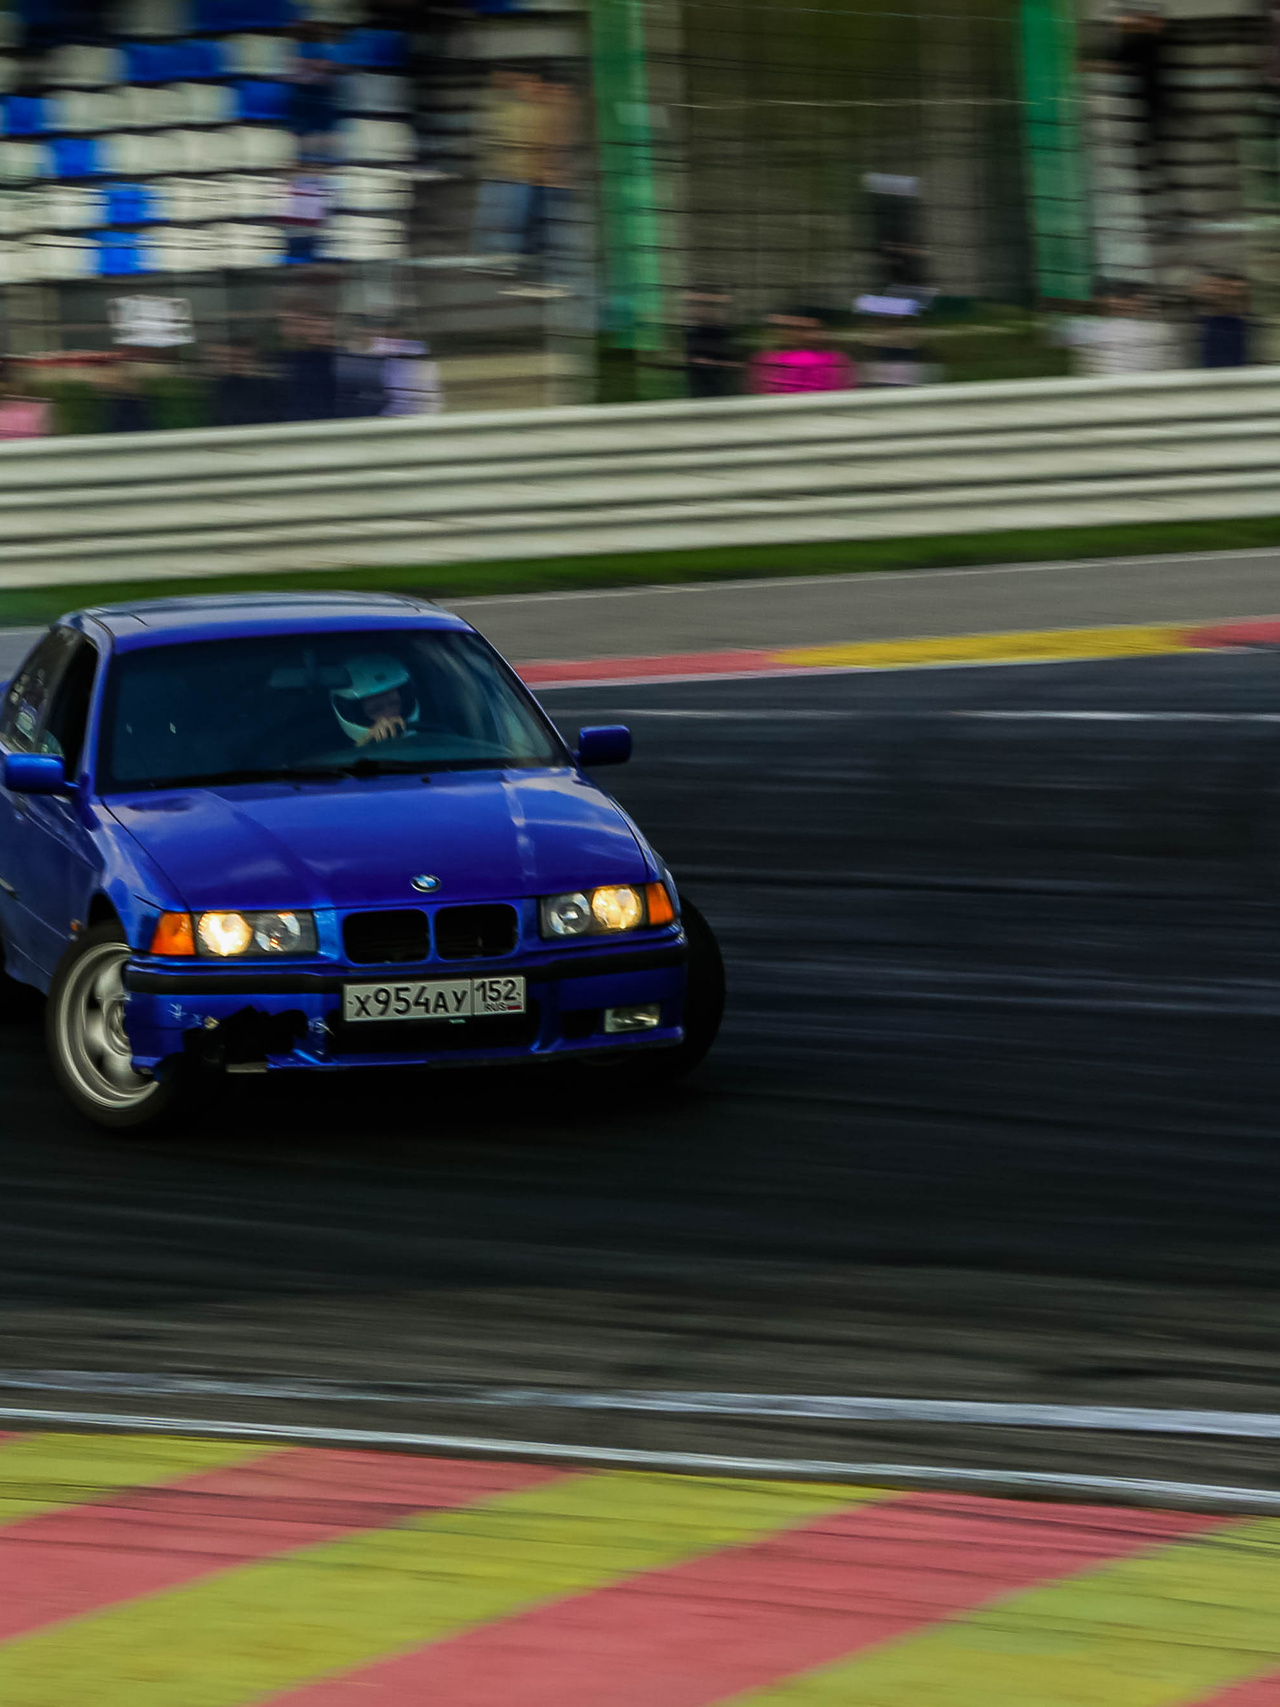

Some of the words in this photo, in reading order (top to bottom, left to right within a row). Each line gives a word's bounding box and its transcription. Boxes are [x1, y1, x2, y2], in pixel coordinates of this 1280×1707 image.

[353, 985, 468, 1017] X954AY
[475, 979, 517, 1002] 152
[484, 1002, 507, 1012] RUS
